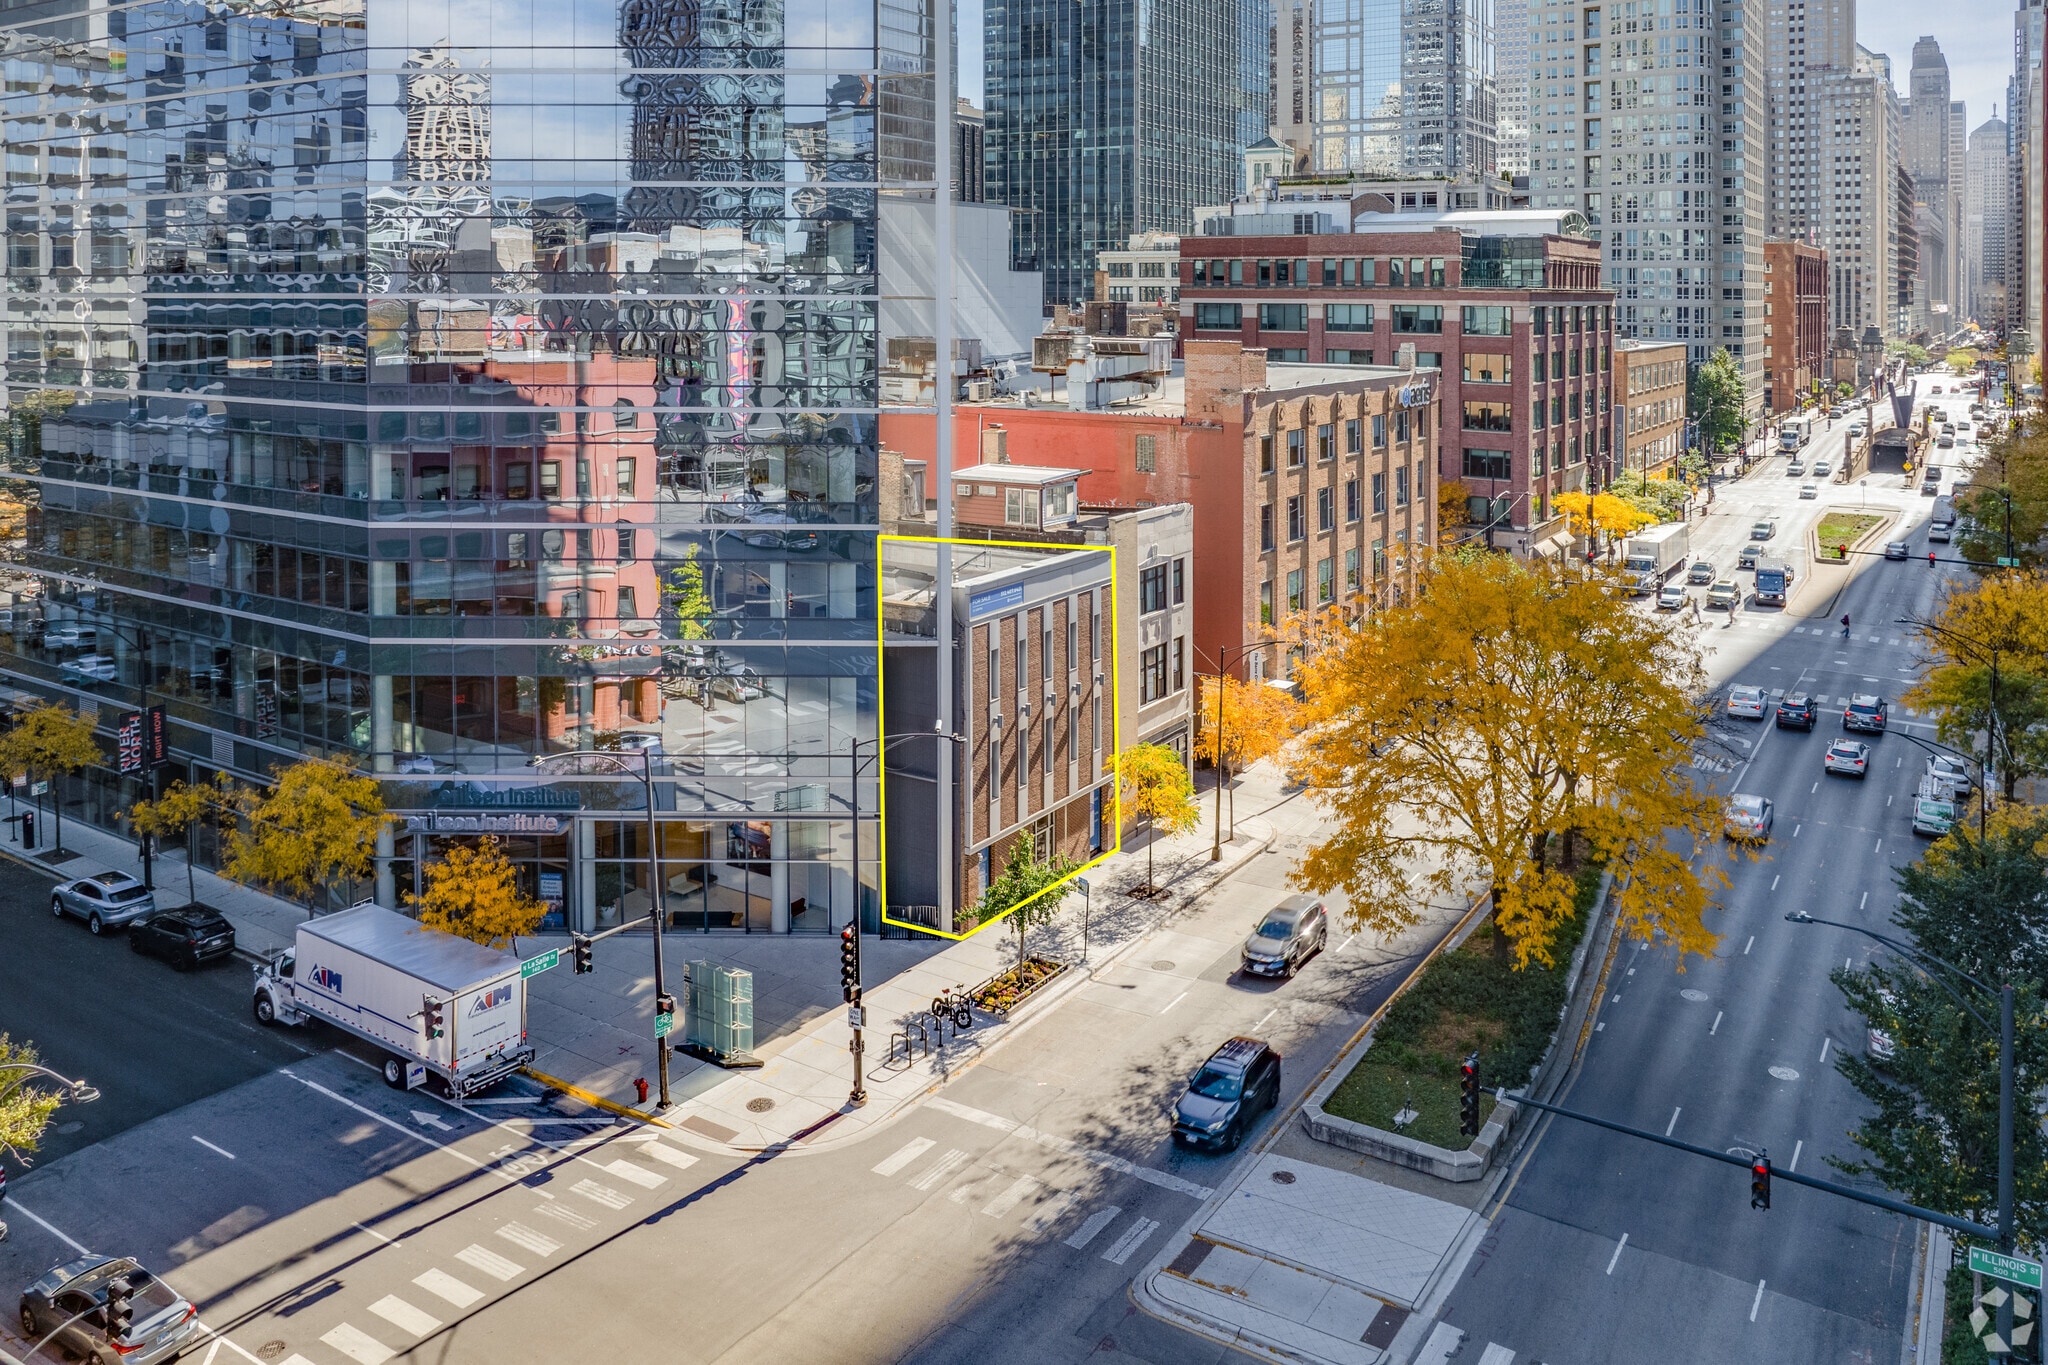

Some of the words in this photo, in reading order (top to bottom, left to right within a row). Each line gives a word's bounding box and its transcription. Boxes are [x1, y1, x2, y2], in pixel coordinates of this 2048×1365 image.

[1410, 377, 1430, 405] aeris
[153, 711, 162, 733] NOW
[119, 726, 131, 773] RIVER
[129, 715, 143, 770] NORTH
[154, 735, 163, 759] RIGHT
[407, 809, 478, 831] erikson
[481, 812, 558, 831] institute
[309, 963, 342, 994] AIM
[469, 984, 512, 1014] AIM
[1972, 1251, 1979, 1259] W
[1982, 1253, 2027, 1273] ILLINOIS
[2030, 1266, 2040, 1276] ST
[1993, 1267, 2009, 1276] 500
